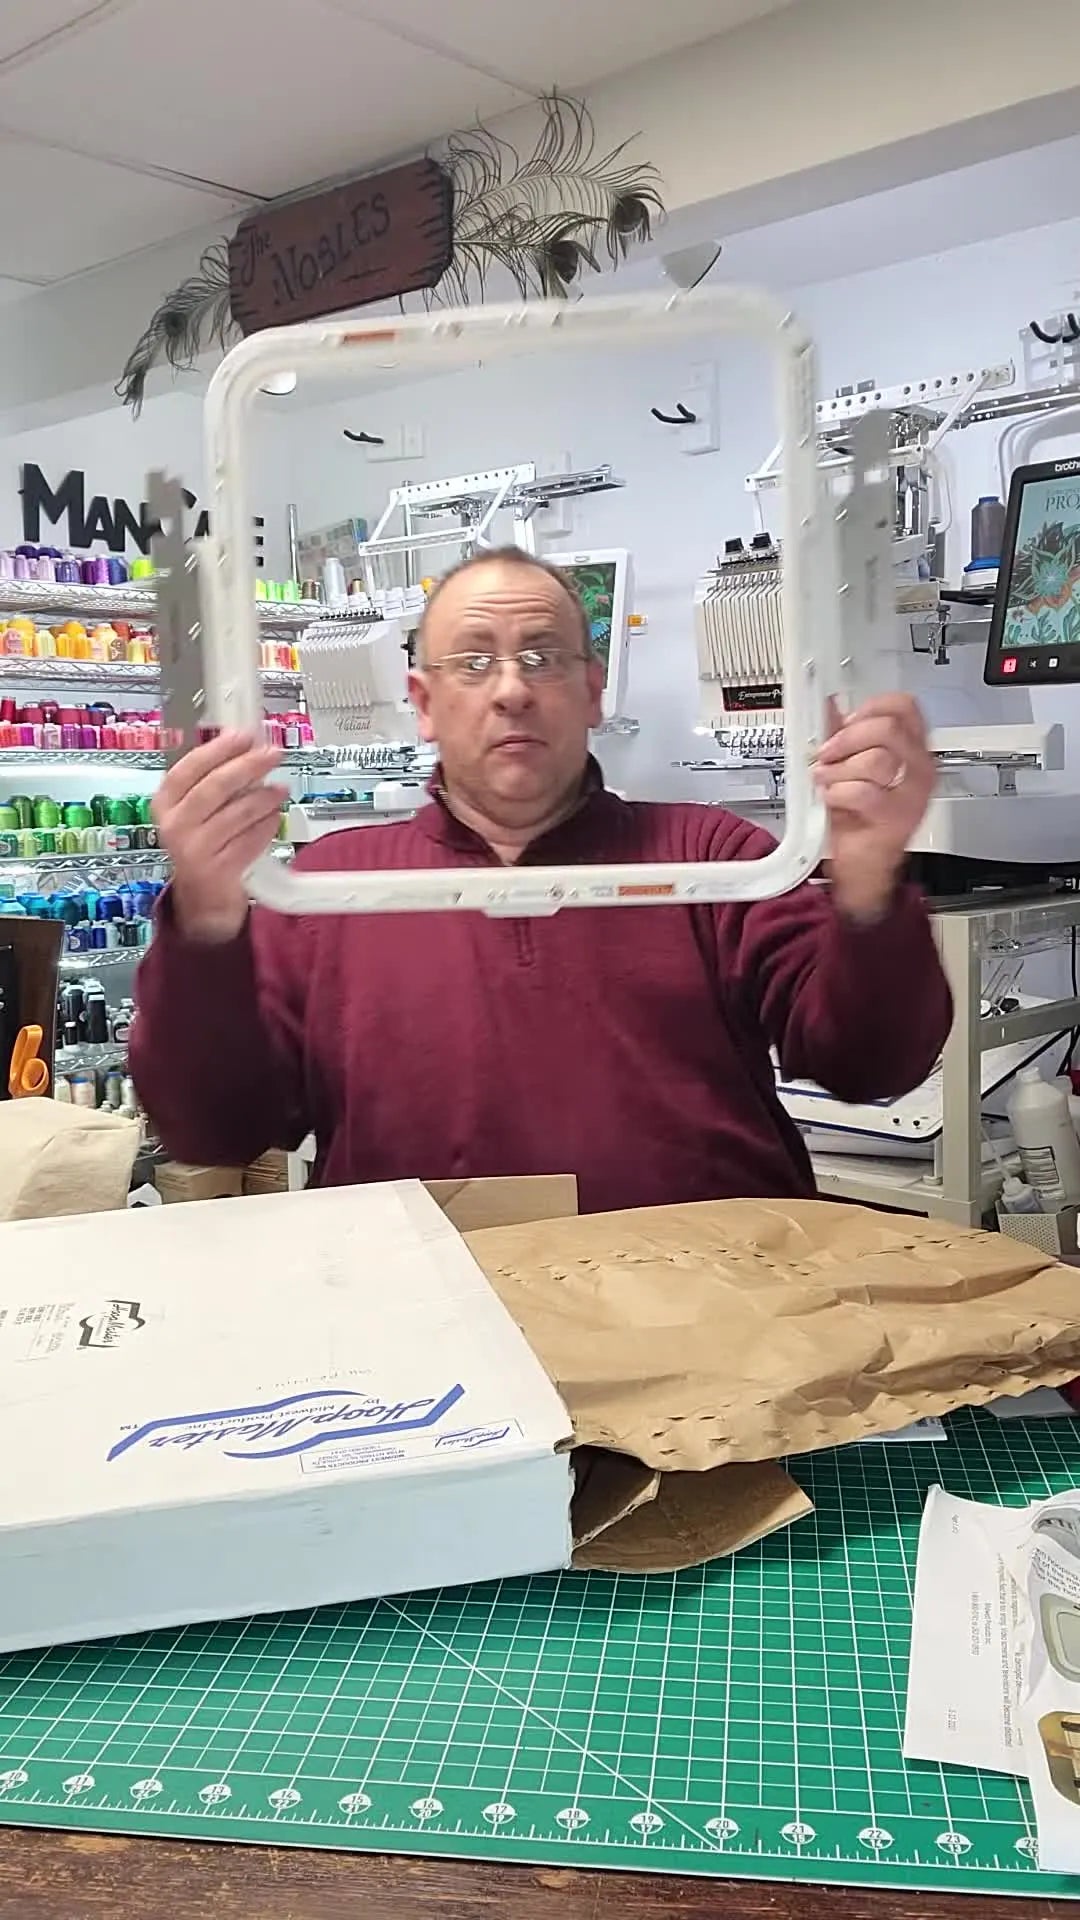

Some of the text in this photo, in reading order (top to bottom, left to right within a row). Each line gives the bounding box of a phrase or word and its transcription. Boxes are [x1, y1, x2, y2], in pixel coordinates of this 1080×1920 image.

[1055, 461, 1080, 471] broth
[9, 1772, 22, 1780] 10
[75, 1776, 88, 1784] 11
[144, 1781, 156, 1789] 12
[211, 1786, 225, 1794] 13
[422, 1801, 434, 1809] 16
[567, 1810, 580, 1818] 18
[642, 1816, 653, 1824] 19
[716, 1820, 729, 1828] 20
[792, 1825, 805, 1833] 21
[868, 1830, 882, 1838] 22
[946, 1835, 961, 1843] 23
